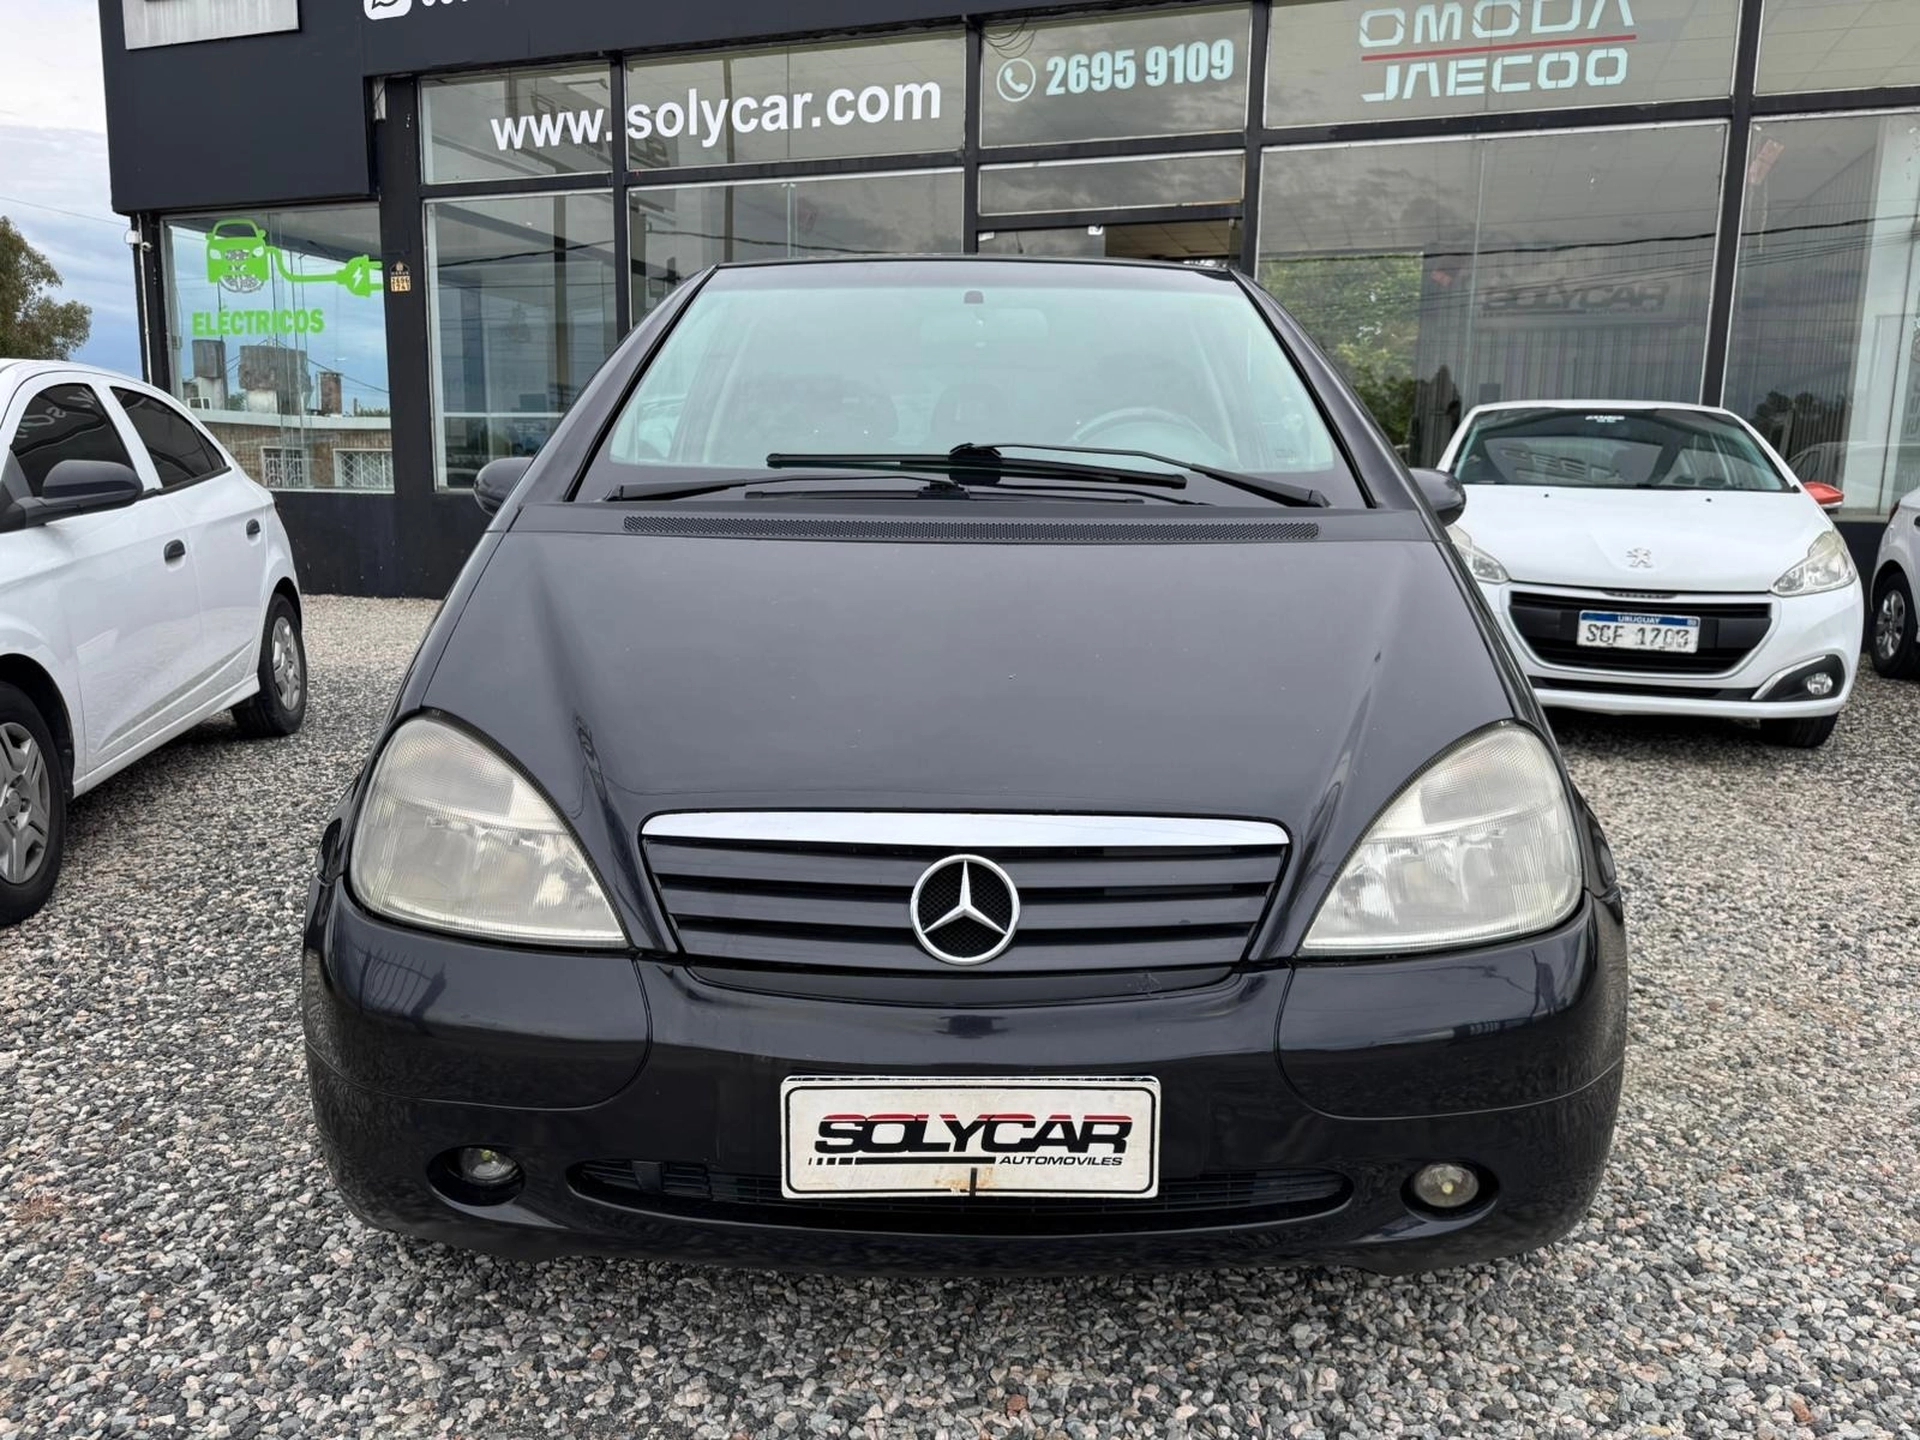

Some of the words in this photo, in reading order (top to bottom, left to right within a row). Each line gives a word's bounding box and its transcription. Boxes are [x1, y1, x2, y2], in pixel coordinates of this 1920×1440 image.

[1359, 0, 1635, 48] OMODA
[1045, 54, 1136, 96] 2695
[1145, 38, 1234, 87] 9109
[1360, 48, 1628, 102] JAECOO
[192, 305, 325, 336] ELÉCTRICOS
[1585, 623, 1625, 643] SCF
[1617, 615, 1661, 624] URUGUAY
[814, 1113, 1133, 1154] SOLYCAR
[1000, 1155, 1124, 1166] AUTOMOVILES
